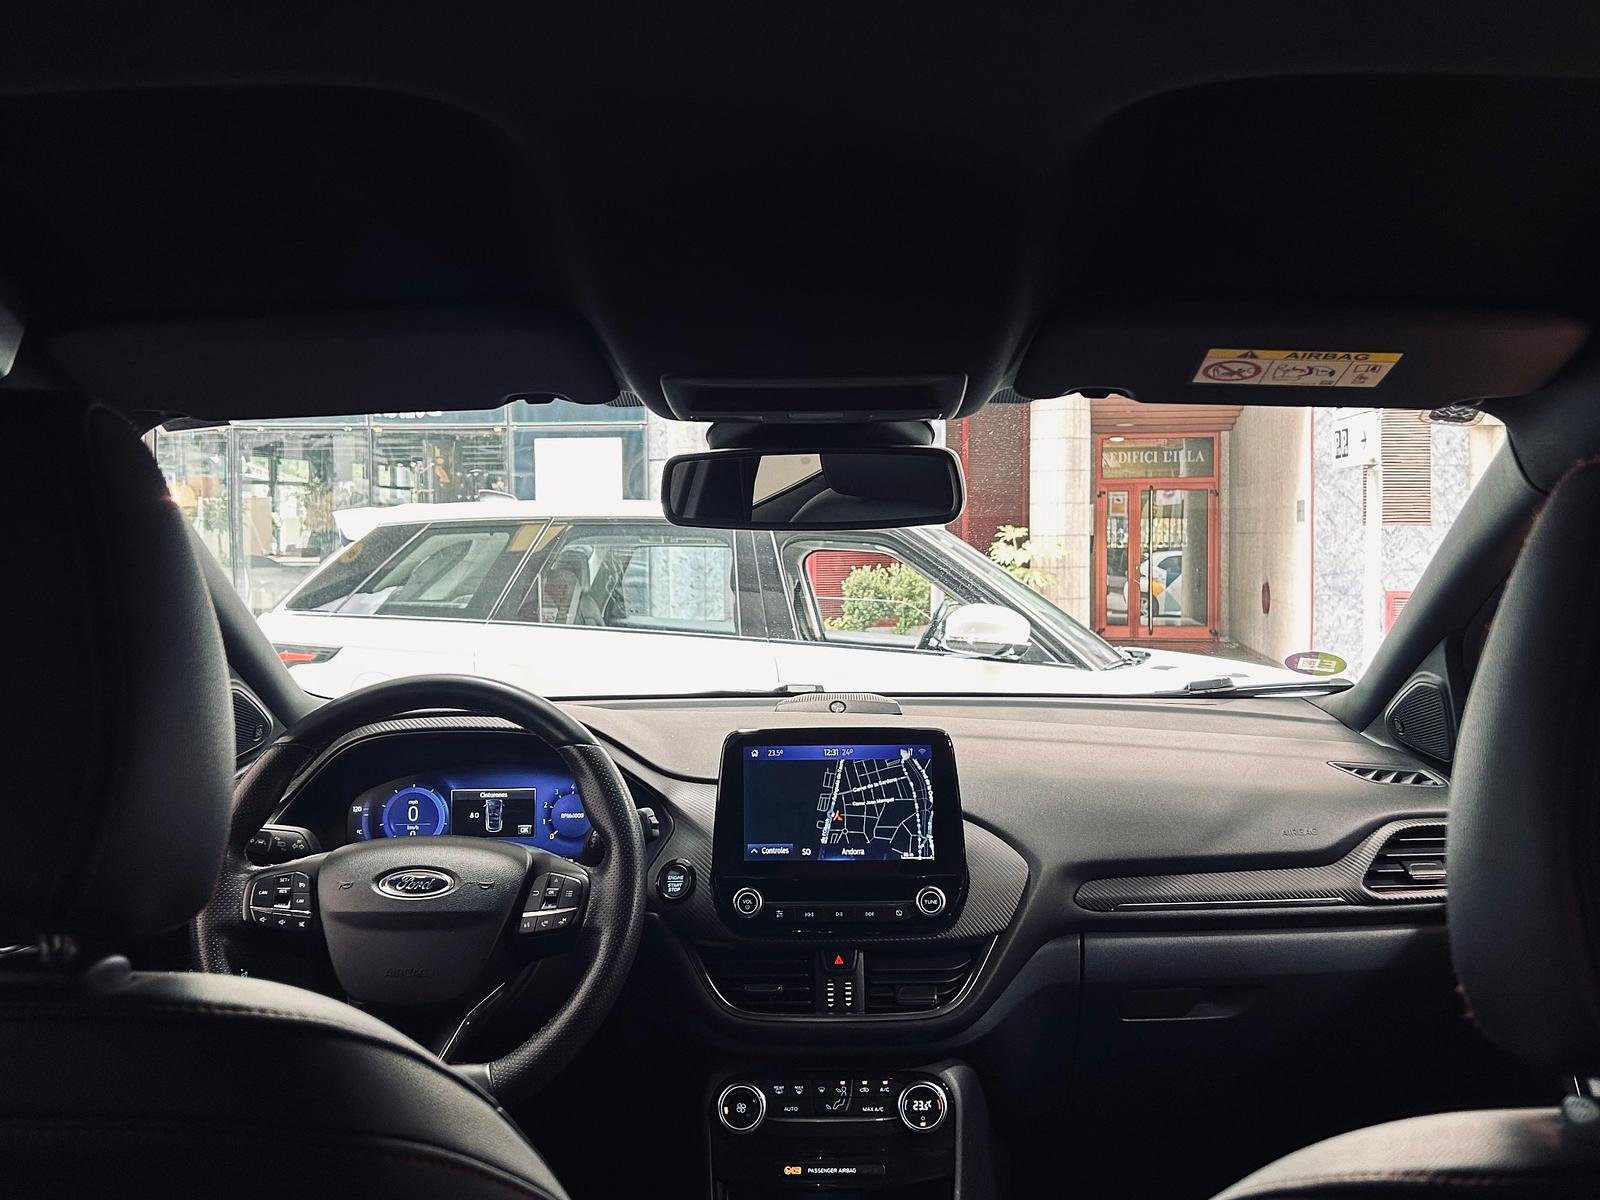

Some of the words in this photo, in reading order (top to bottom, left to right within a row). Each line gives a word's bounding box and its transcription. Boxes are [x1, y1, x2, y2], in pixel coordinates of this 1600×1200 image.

[1284, 352, 1370, 361] AIRBAG
[1110, 450, 1157, 463] EDIFICI
[824, 748, 839, 757] 12:31
[408, 806, 418, 822] 0
[761, 846, 790, 855] Controles
[842, 847, 865, 856] Andorra
[395, 875, 434, 891] Ford
